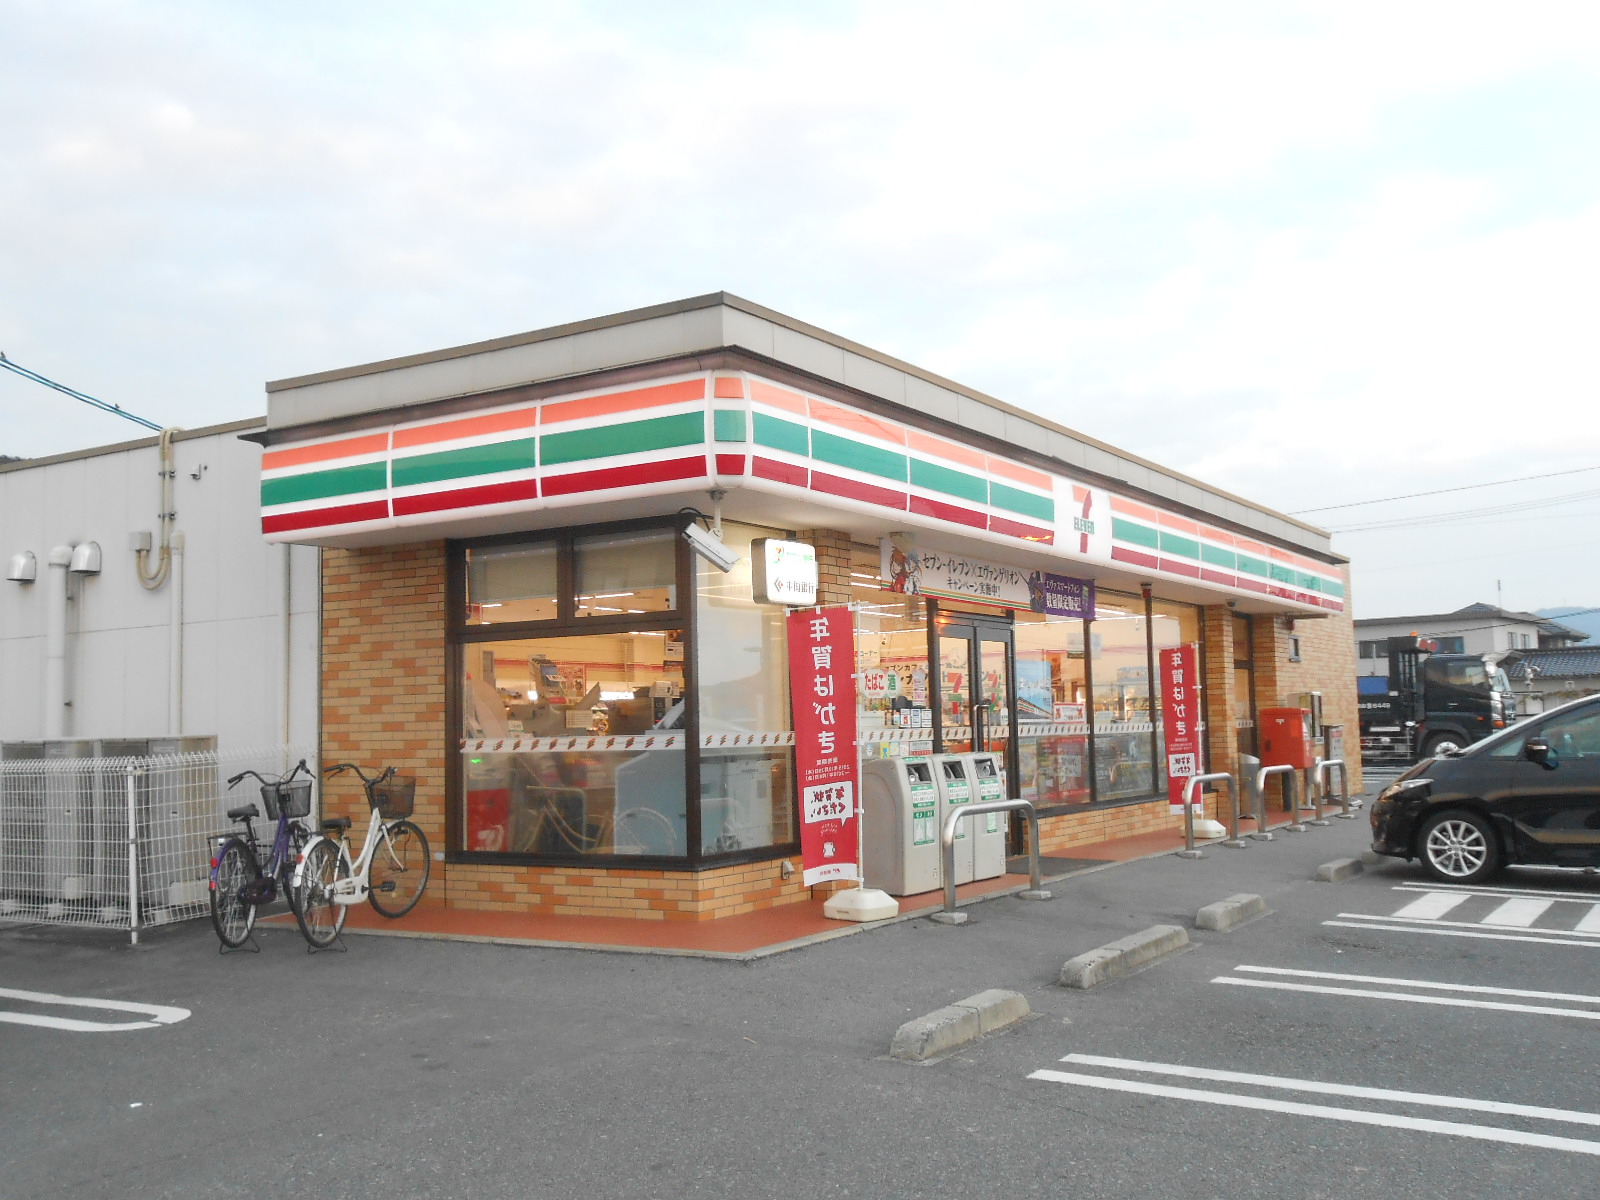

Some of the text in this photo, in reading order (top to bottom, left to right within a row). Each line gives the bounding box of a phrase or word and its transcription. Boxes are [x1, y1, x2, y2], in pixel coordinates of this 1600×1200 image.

[1072, 485, 1093, 553] 7
[865, 673, 885, 691] たばこ
